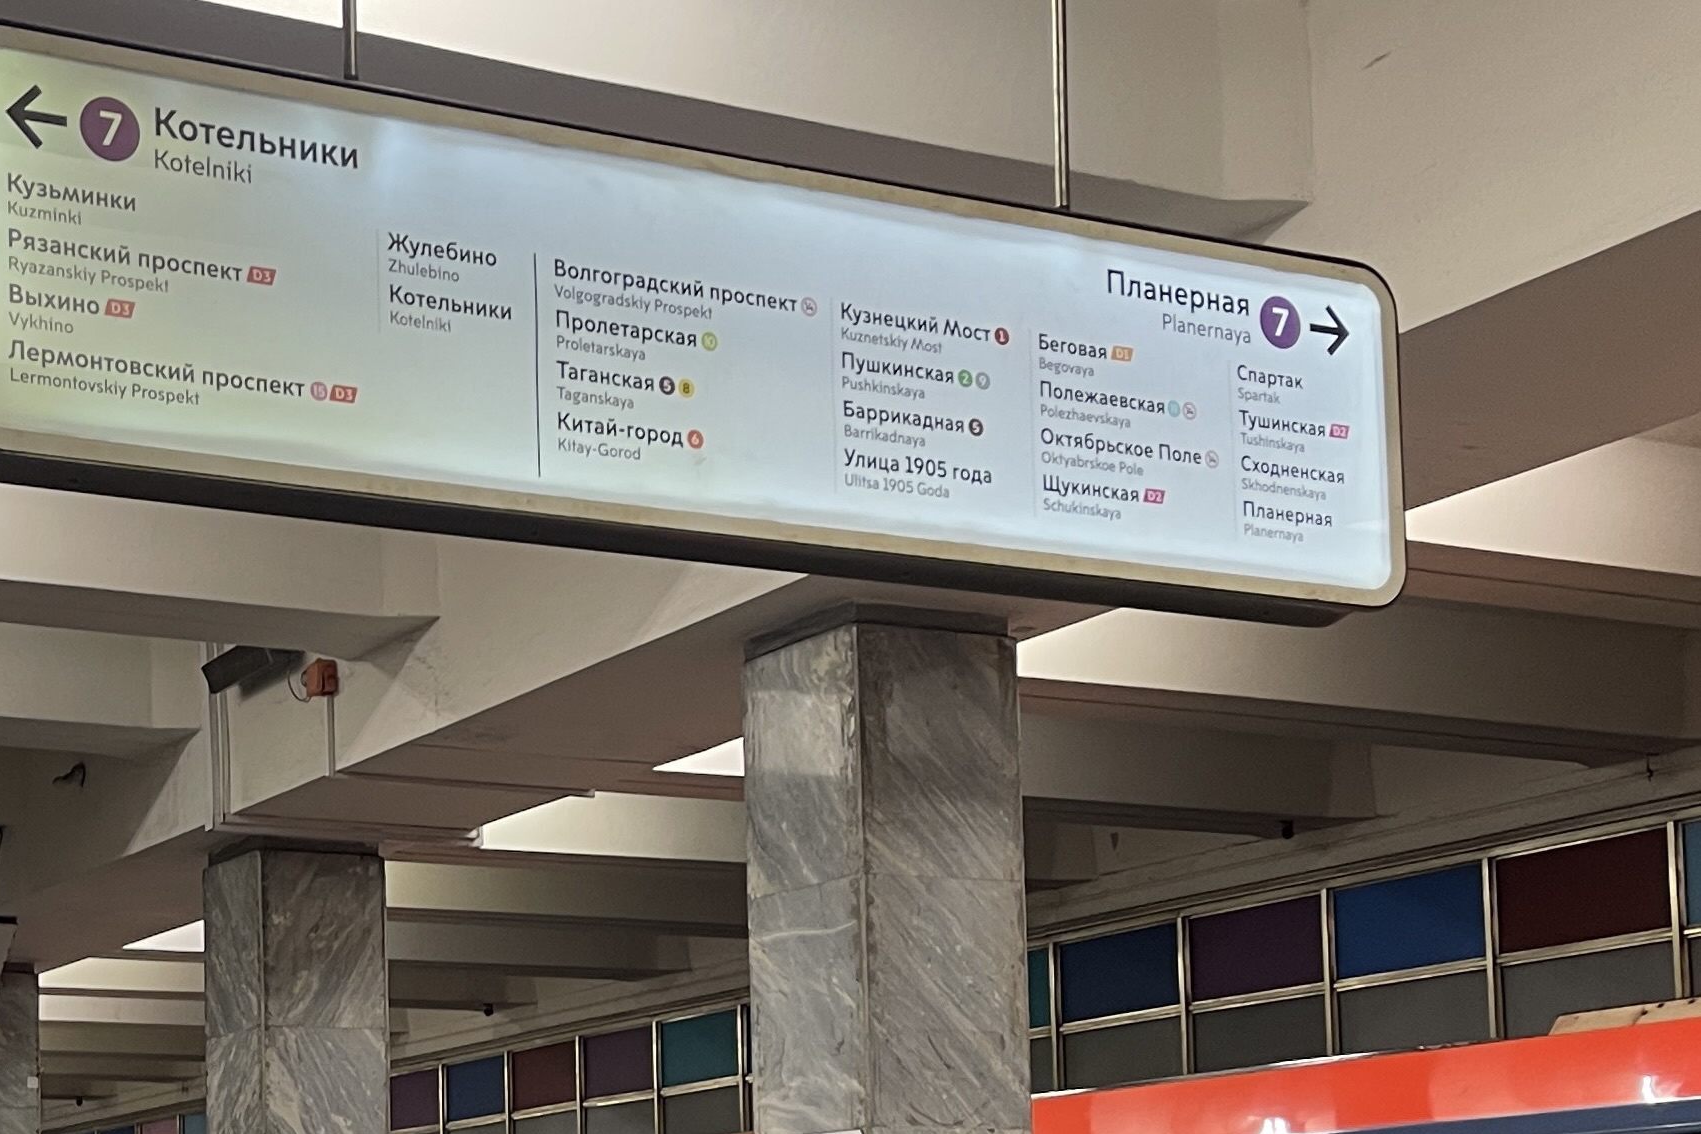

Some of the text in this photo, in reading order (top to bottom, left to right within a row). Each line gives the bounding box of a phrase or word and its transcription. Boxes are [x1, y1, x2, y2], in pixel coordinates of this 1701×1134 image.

[97, 107, 359, 168] 7 Котельники
[154, 150, 253, 184] Kotelniki
[7, 173, 137, 212] Кузьминки
[7, 202, 82, 225] Kuzminki
[8, 229, 273, 284] Рязанский проспект D3
[387, 232, 498, 267] Жулебино
[8, 256, 169, 294] Ryazanskiy Prospekt
[388, 258, 460, 283] Zhulebino
[554, 259, 704, 298] Волгоградский
[710, 285, 798, 313] проспект
[8, 285, 132, 317] Выхино D3
[388, 285, 512, 320] Котельники
[554, 284, 713, 321] Volgogradskiy Prospekt
[1107, 269, 1290, 337] Планерная 7
[9, 312, 74, 335] Vykhino
[389, 311, 452, 334] Kotelniki
[556, 310, 697, 348] Пролетарская
[841, 303, 938, 335] Кузнецкий
[943, 320, 990, 343] Мост
[1162, 314, 1252, 346] Planernaya
[556, 335, 646, 362] Proletarskaya
[841, 328, 942, 354] Kuznetskiy Most
[1039, 334, 1131, 360] Беговая D1
[8, 339, 195, 384] Лермонтовский
[201, 366, 305, 399] проспект
[334, 386, 354, 401] D3
[556, 361, 654, 392] Таганская
[841, 353, 954, 384] Пушкинская
[1039, 358, 1094, 378] Begovaya
[1237, 365, 1304, 391] Спартак
[9, 369, 200, 406] Lermontovskiy Prospekt
[556, 386, 634, 410] Taganskaya
[842, 377, 925, 400] Pushkinskaya
[1040, 381, 1165, 414] Полежаевская
[1237, 387, 1280, 405] Spartak
[557, 413, 683, 448] Китай-город
[843, 402, 964, 434] Баррикадная
[1040, 405, 1131, 429] Polezhaevskaya
[1239, 410, 1348, 437] Тушинская D2
[558, 438, 641, 461] Kitay-Gorod
[844, 425, 926, 448] Barrikadnaya
[1040, 428, 1154, 459] Октябрьское
[1159, 444, 1201, 465] Поле
[1240, 432, 1305, 453] Tushinskaya
[844, 449, 992, 485] Улица 1905 года
[1041, 451, 1144, 477] Oktyabrskoe Pole
[1241, 457, 1345, 485] Сходненская
[844, 474, 950, 498] Ulitsa 1905 Goda
[1043, 475, 1163, 503] Щукинская D2
[1241, 478, 1326, 501] Skhodnenskaya
[1043, 498, 1121, 521] Schukinskaya
[1243, 501, 1333, 528] Планерная
[1244, 524, 1304, 544] Planernaya
